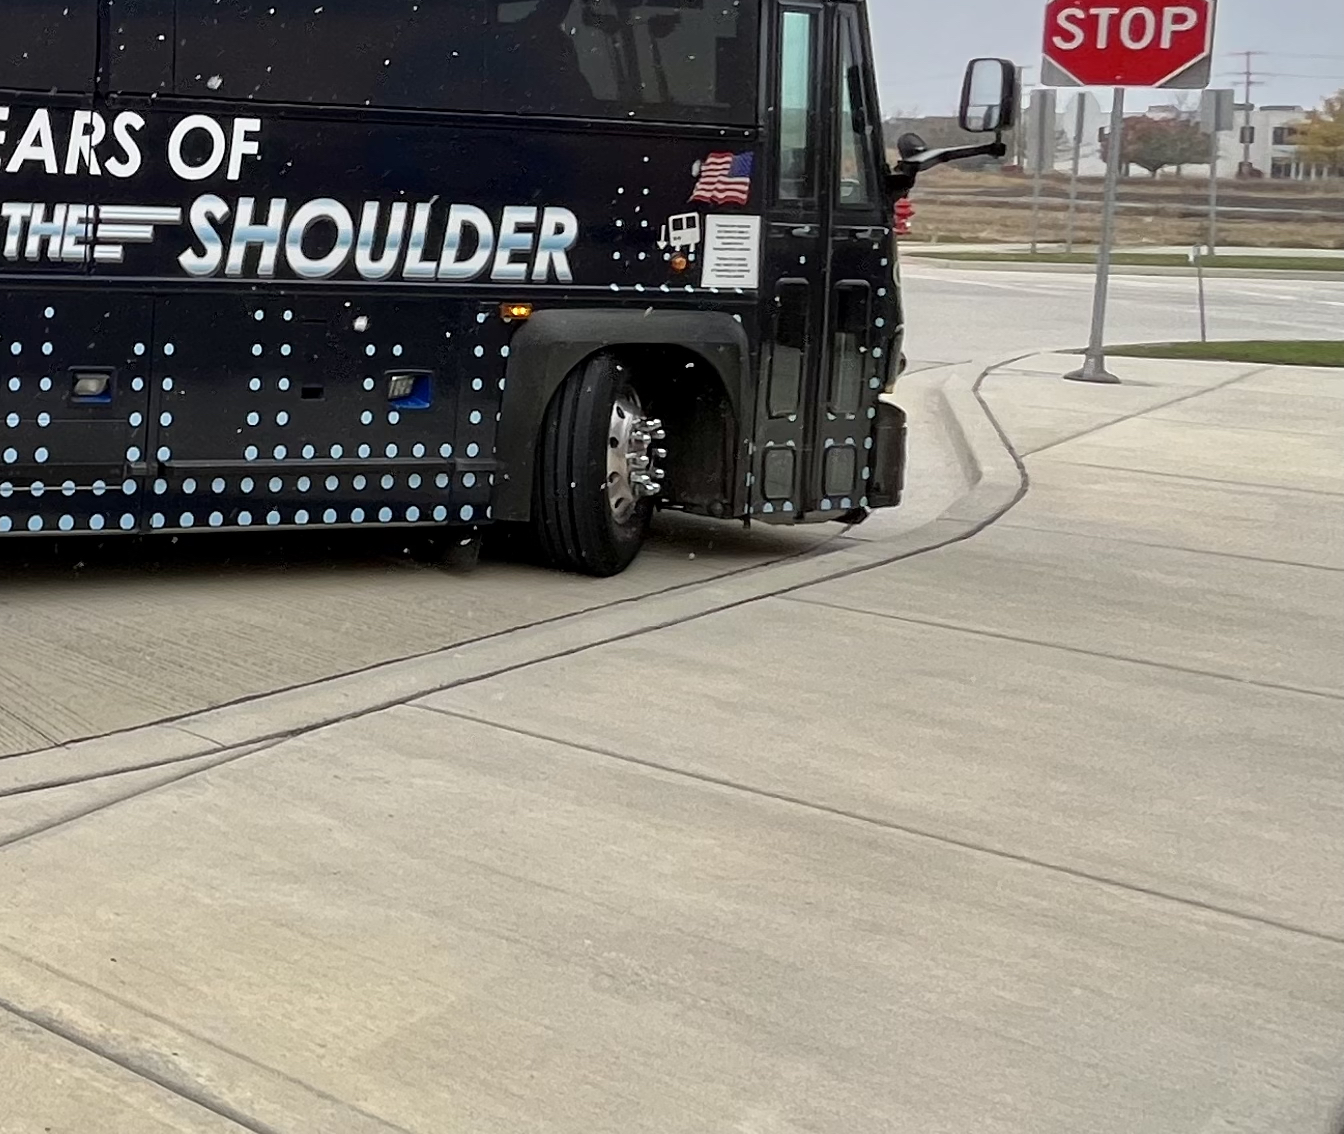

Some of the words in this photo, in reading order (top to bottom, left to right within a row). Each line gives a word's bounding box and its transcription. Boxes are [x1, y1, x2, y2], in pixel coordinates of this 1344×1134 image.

[1052, 6, 1198, 50] STOP
[167, 114, 262, 181] OF
[1, 201, 88, 262] THE
[177, 193, 579, 282] SHOULDER
